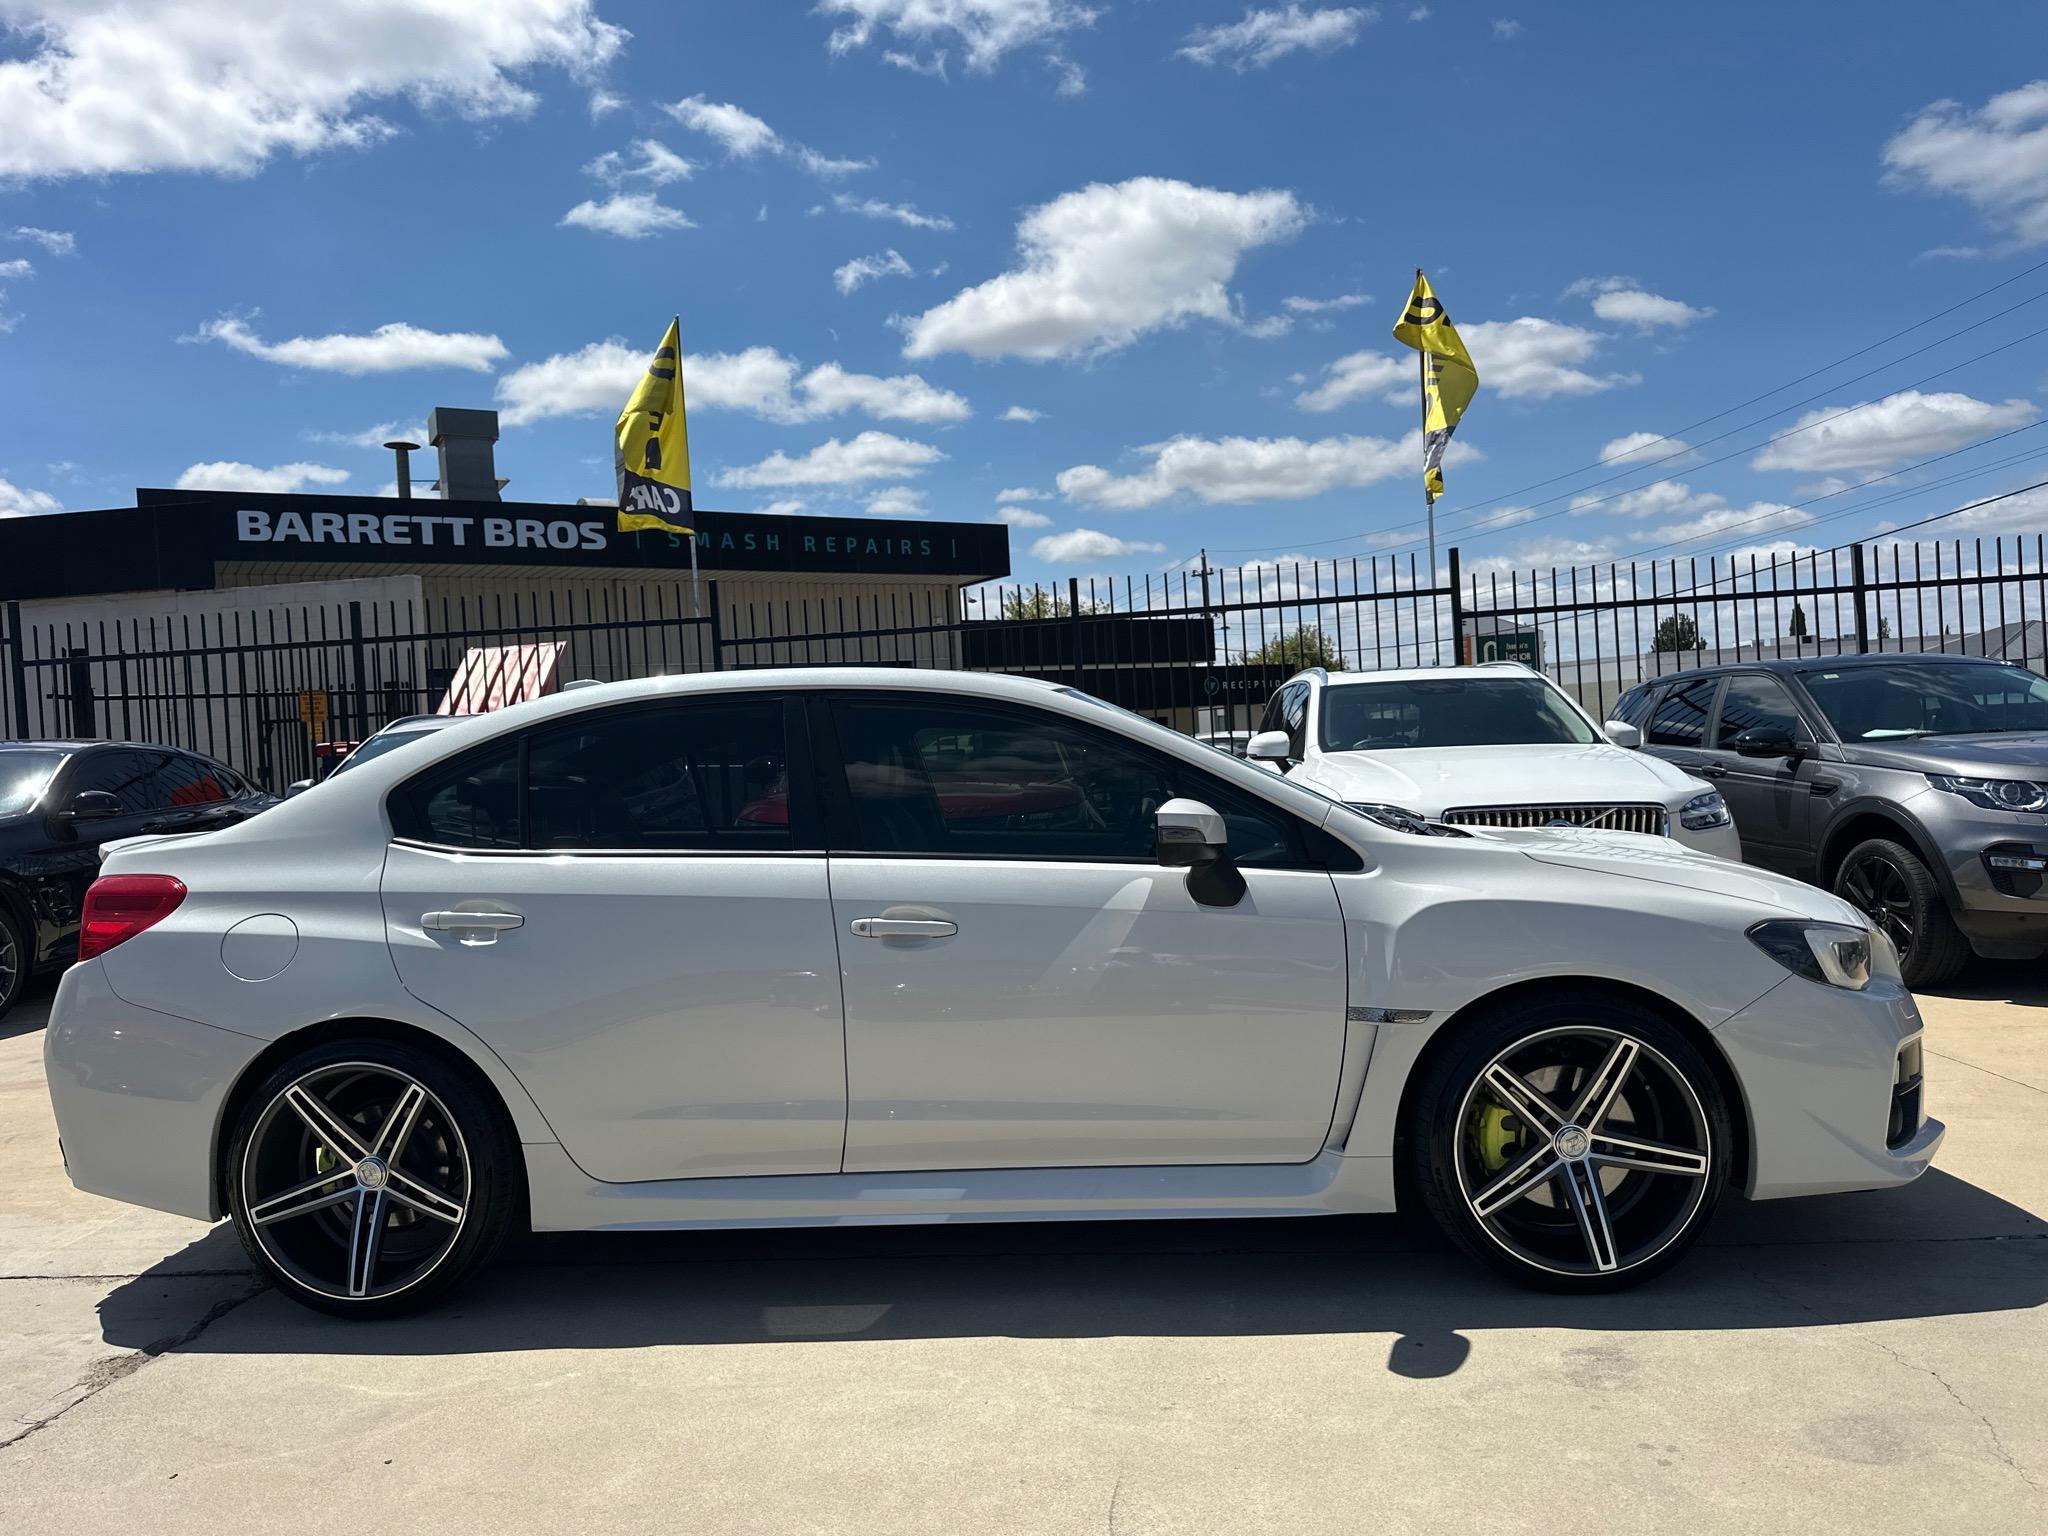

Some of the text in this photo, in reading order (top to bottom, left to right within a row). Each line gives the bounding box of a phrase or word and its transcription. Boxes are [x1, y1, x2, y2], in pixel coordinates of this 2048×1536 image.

[236, 509, 608, 551] BARRETT BROS
[667, 531, 932, 556] SMASH REPAIRS
[1221, 679, 1284, 690] RECEPTIO
